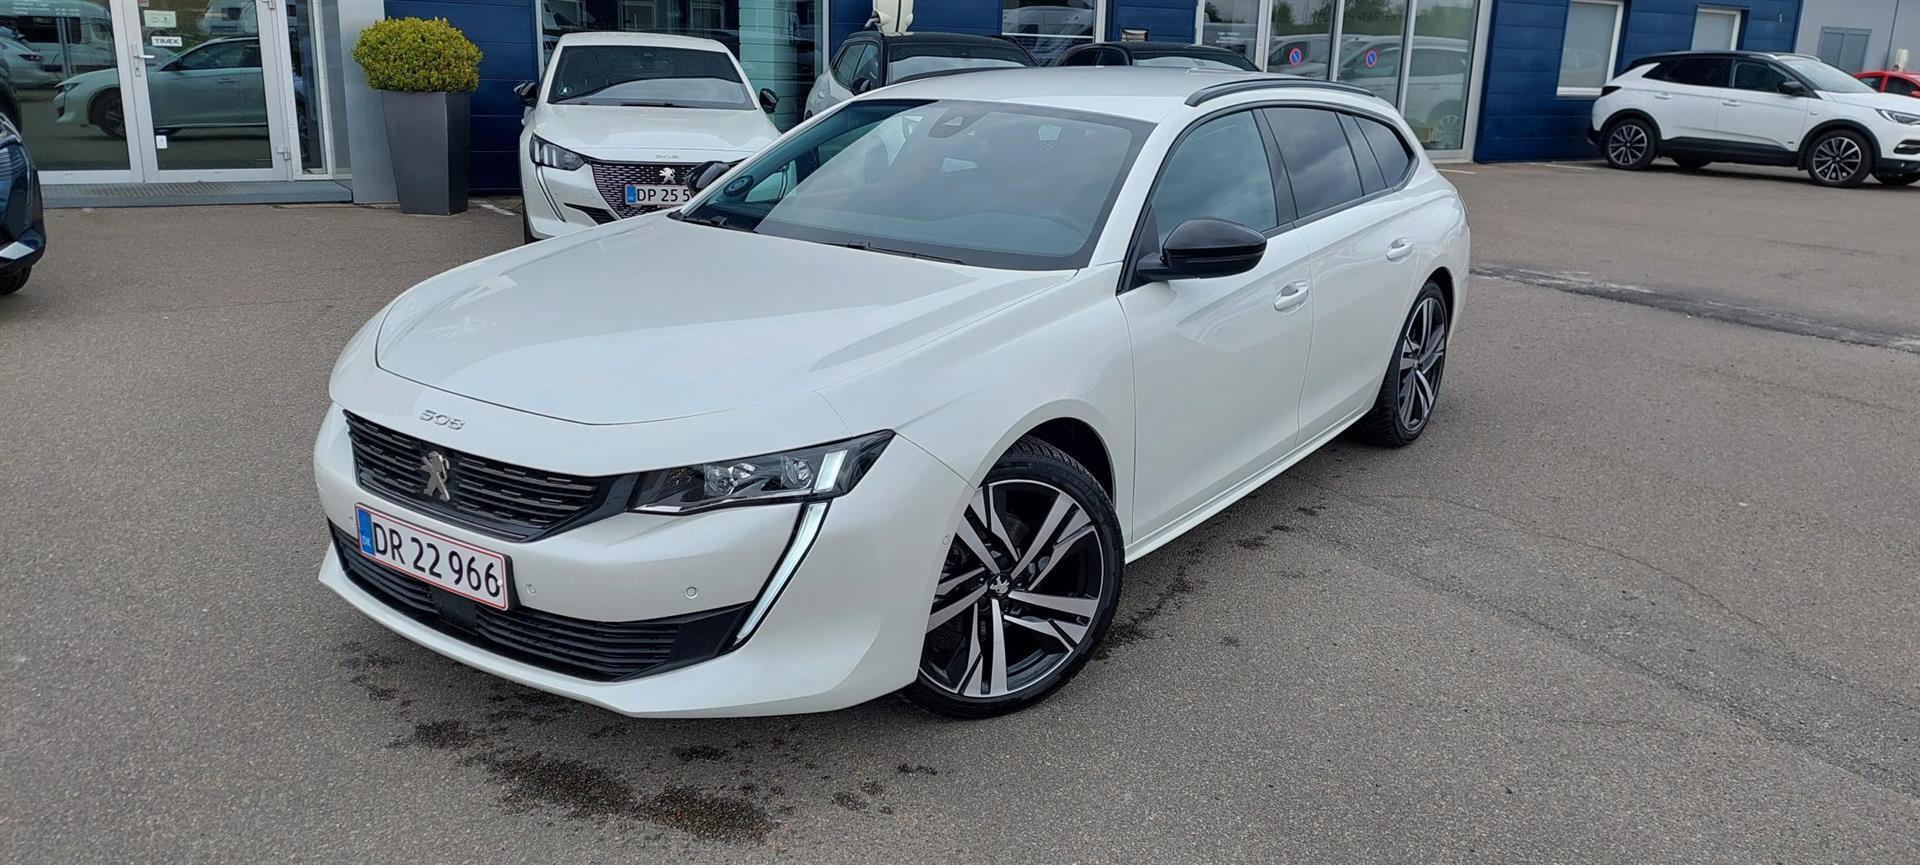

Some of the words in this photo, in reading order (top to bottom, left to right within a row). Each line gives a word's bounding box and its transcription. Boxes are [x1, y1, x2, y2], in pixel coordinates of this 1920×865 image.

[637, 189, 657, 202] DP
[661, 189, 678, 202] 25
[420, 409, 465, 430] 508
[373, 522, 406, 565] DR
[410, 536, 442, 579] 22
[448, 550, 500, 598] 966
